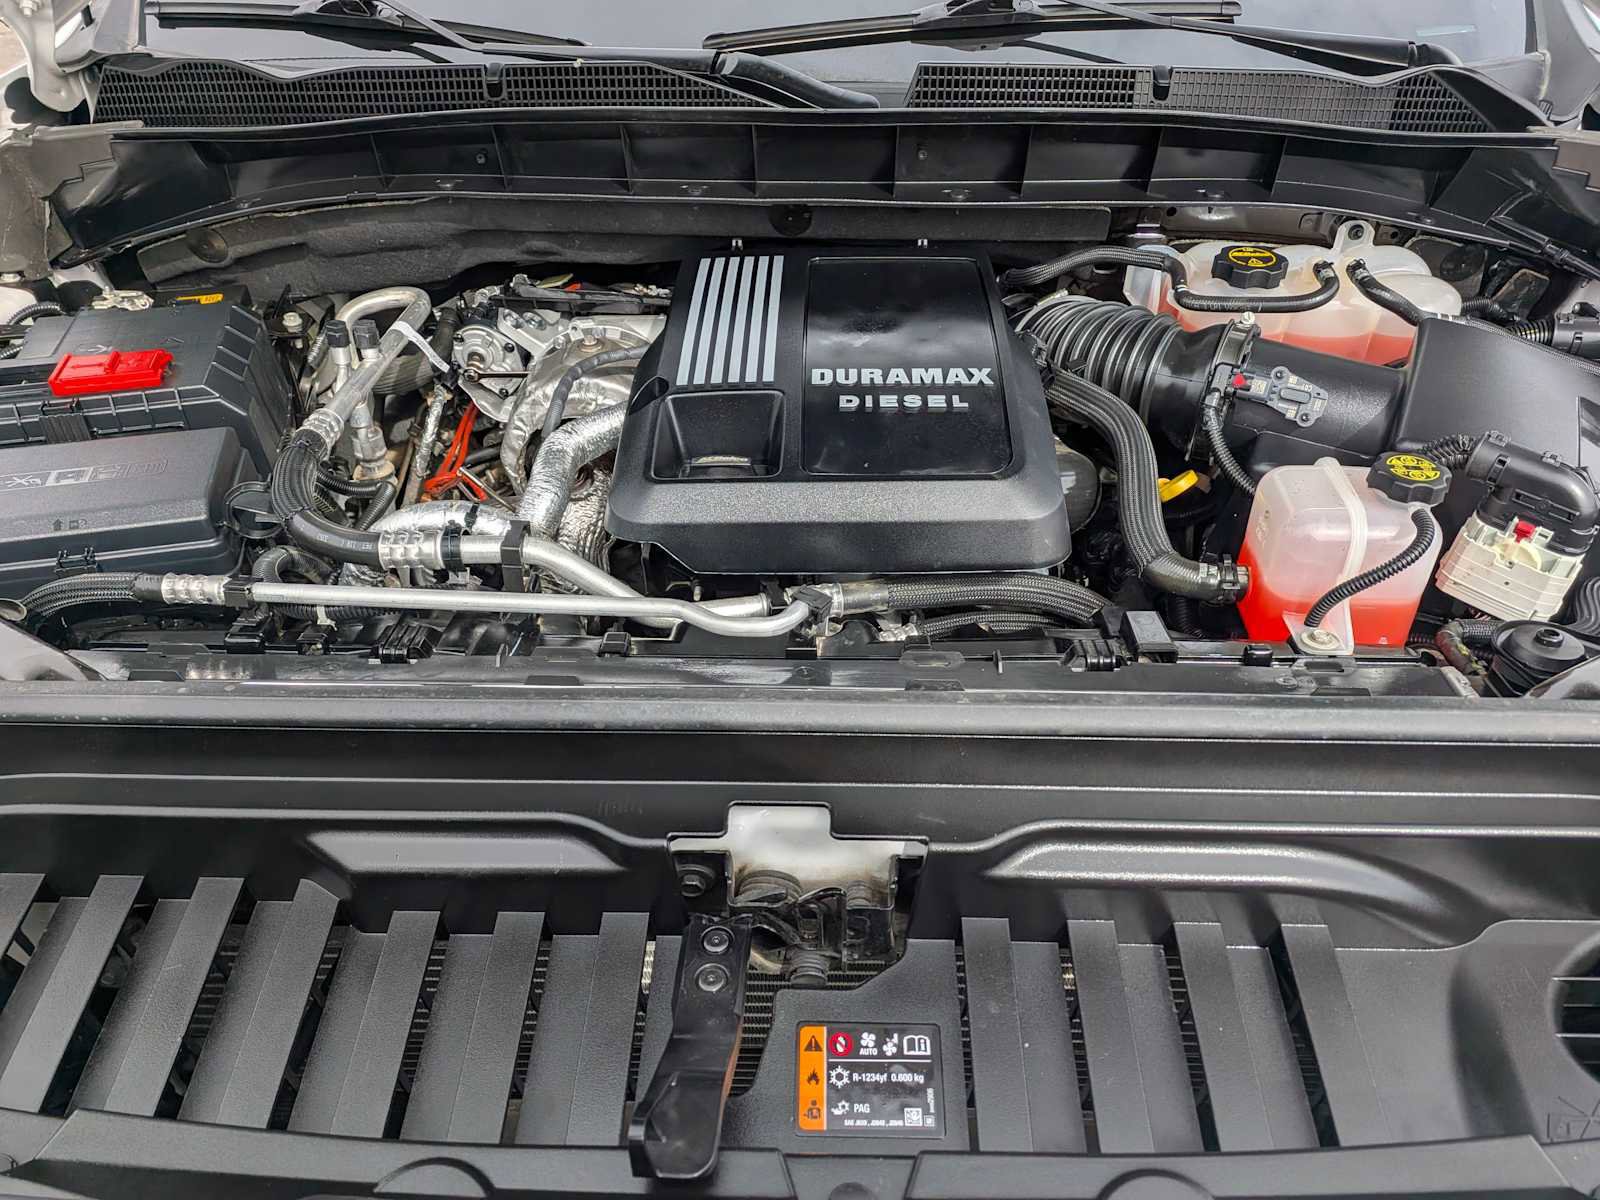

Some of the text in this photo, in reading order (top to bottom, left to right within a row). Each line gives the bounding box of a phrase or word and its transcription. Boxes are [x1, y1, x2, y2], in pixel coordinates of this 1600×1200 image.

[811, 367, 994, 385] DURAMAX
[839, 395, 969, 410] DIESEL
[859, 1047, 878, 1056] AUTO
[852, 1072, 888, 1084] R-1234yf
[914, 1072, 925, 1084] kg
[853, 1103, 871, 1114] PAG
